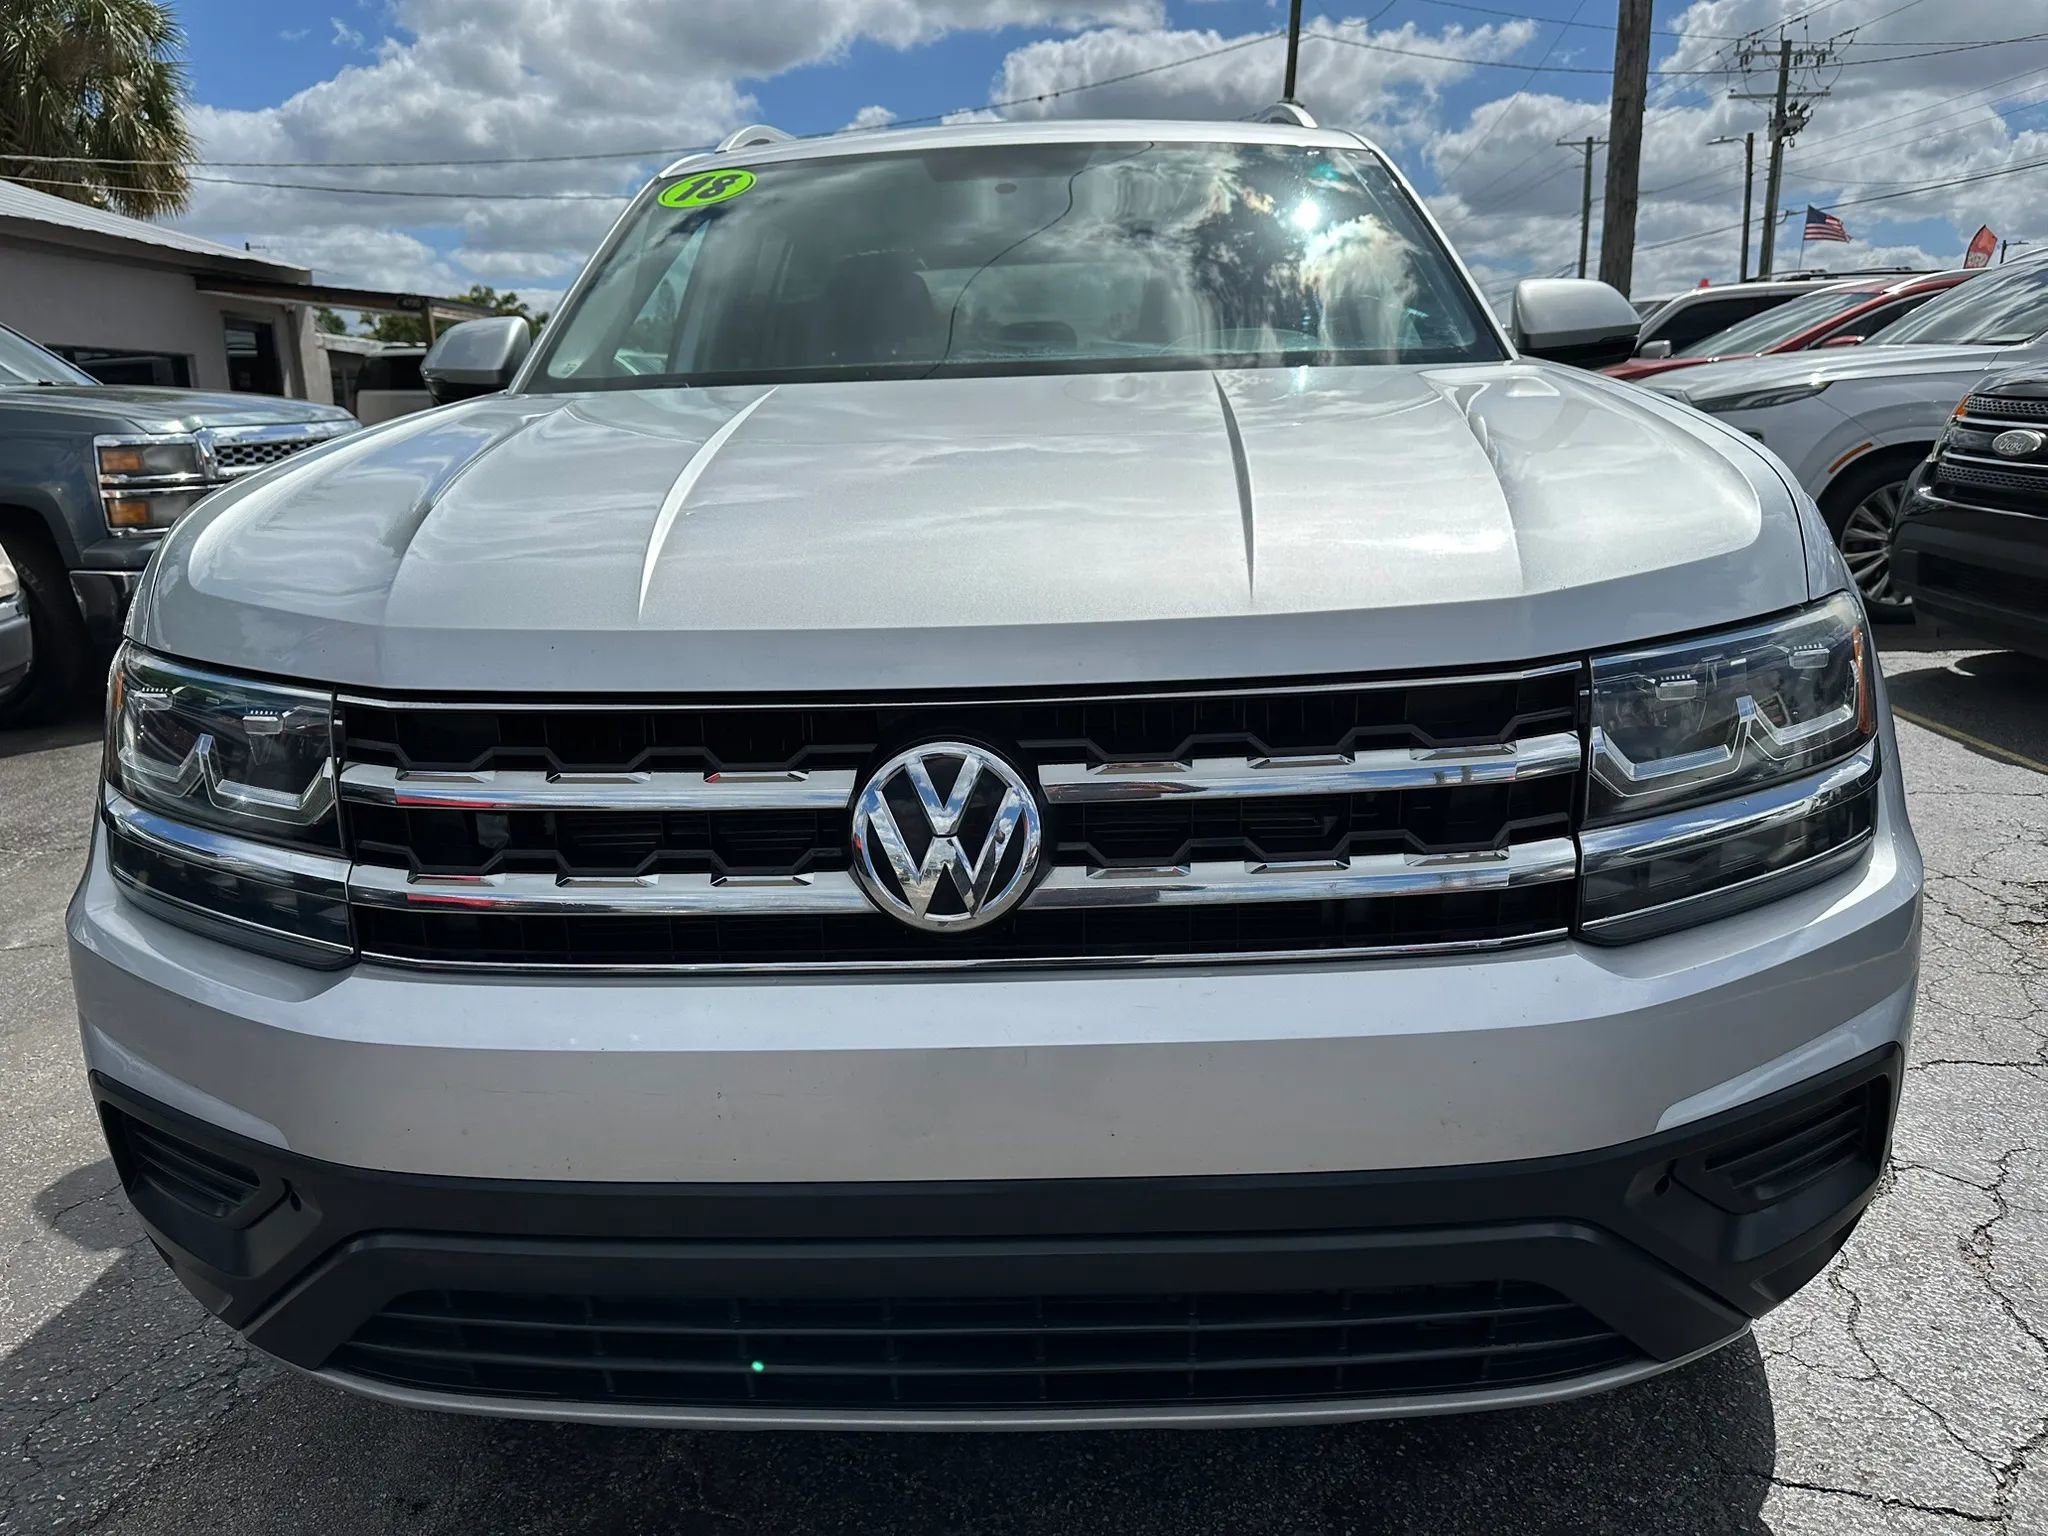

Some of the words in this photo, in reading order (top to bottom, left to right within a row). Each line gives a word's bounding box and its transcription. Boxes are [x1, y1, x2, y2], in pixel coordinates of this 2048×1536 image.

[673, 174, 743, 201] 18
[1998, 434, 2027, 451] Ford
[864, 750, 1027, 920] VW
